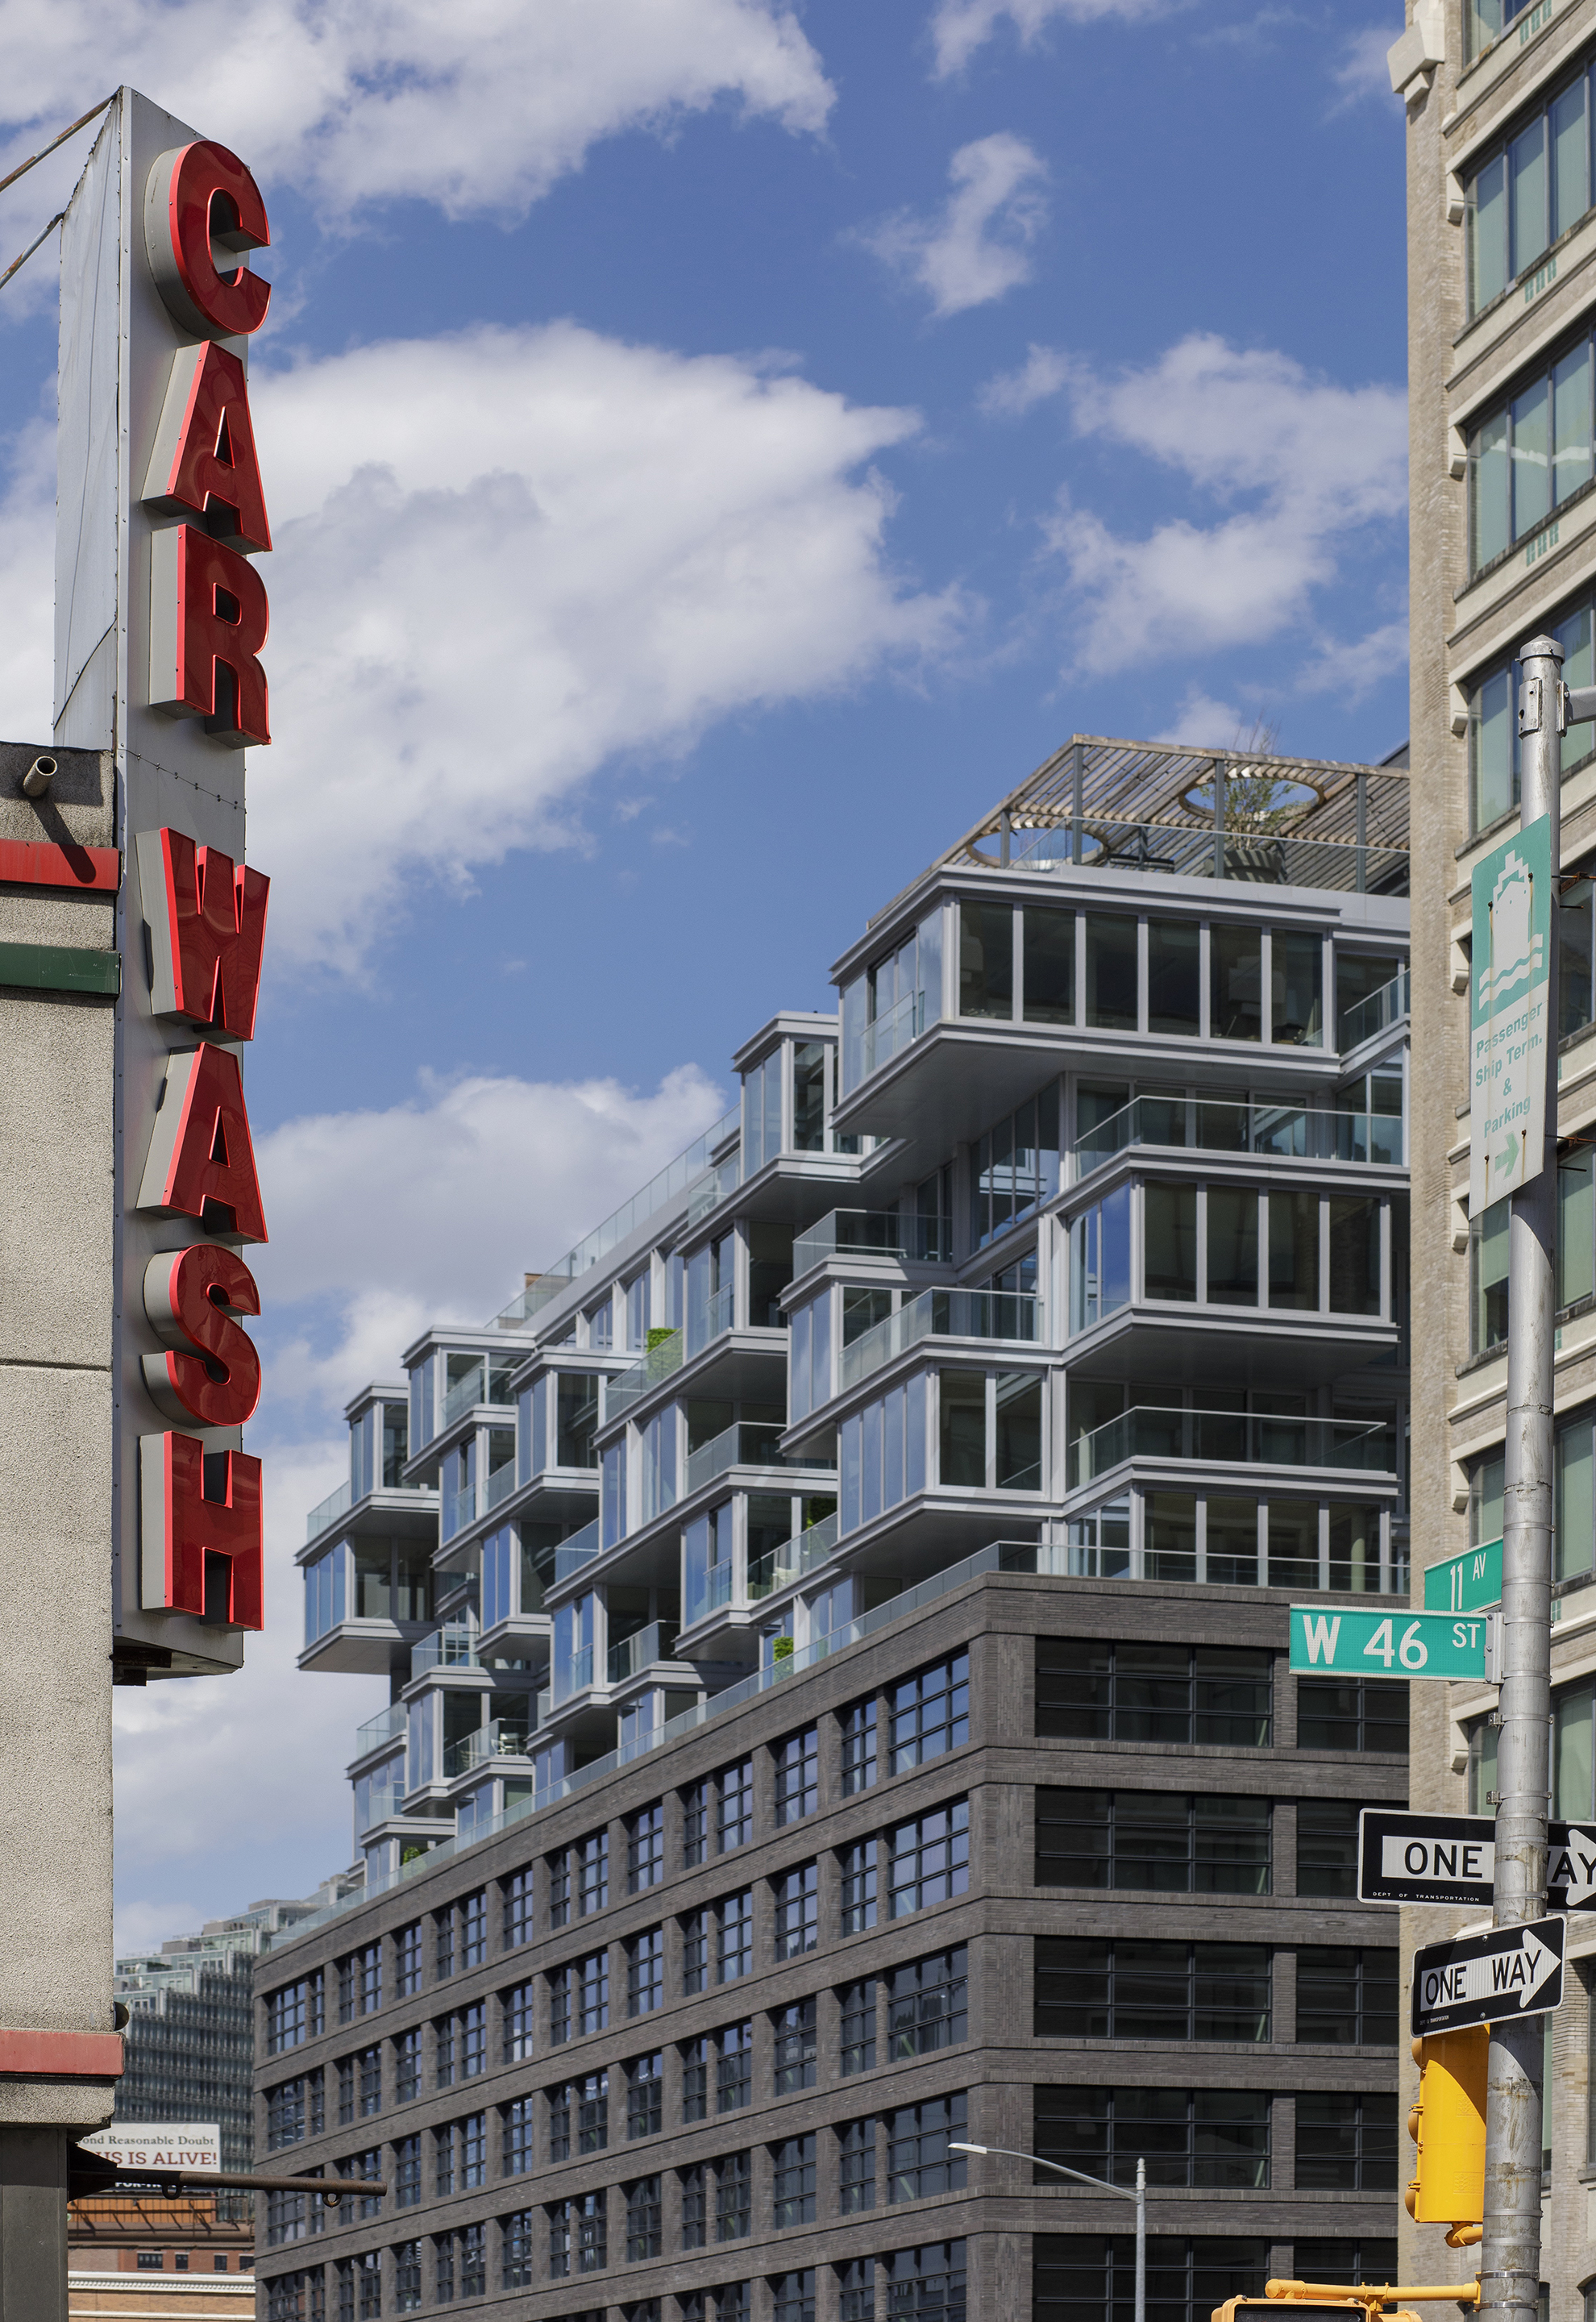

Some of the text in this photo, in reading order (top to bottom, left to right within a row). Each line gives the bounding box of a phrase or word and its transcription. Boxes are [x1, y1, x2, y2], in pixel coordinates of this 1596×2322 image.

[157, 140, 273, 1631] CAR WASH
[1476, 1002, 1543, 1059] Passenger
[1475, 1033, 1543, 1088] Ship Term.
[1502, 1077, 1512, 1096] &
[1484, 1096, 1531, 1138] Parking
[1450, 1552, 1486, 1612] 11 AV
[1302, 1614, 1481, 1670] W 46 ST
[1404, 1841, 1596, 1885] ONE AY
[1415, 1894, 1480, 1902] TRANSPORTATION
[1425, 1949, 1542, 2006] ONE WAY
[78, 2135, 214, 2145] ond Reasonable Doubt
[128, 2151, 147, 2165] IS
[152, 2151, 217, 2166] ALIVE!
